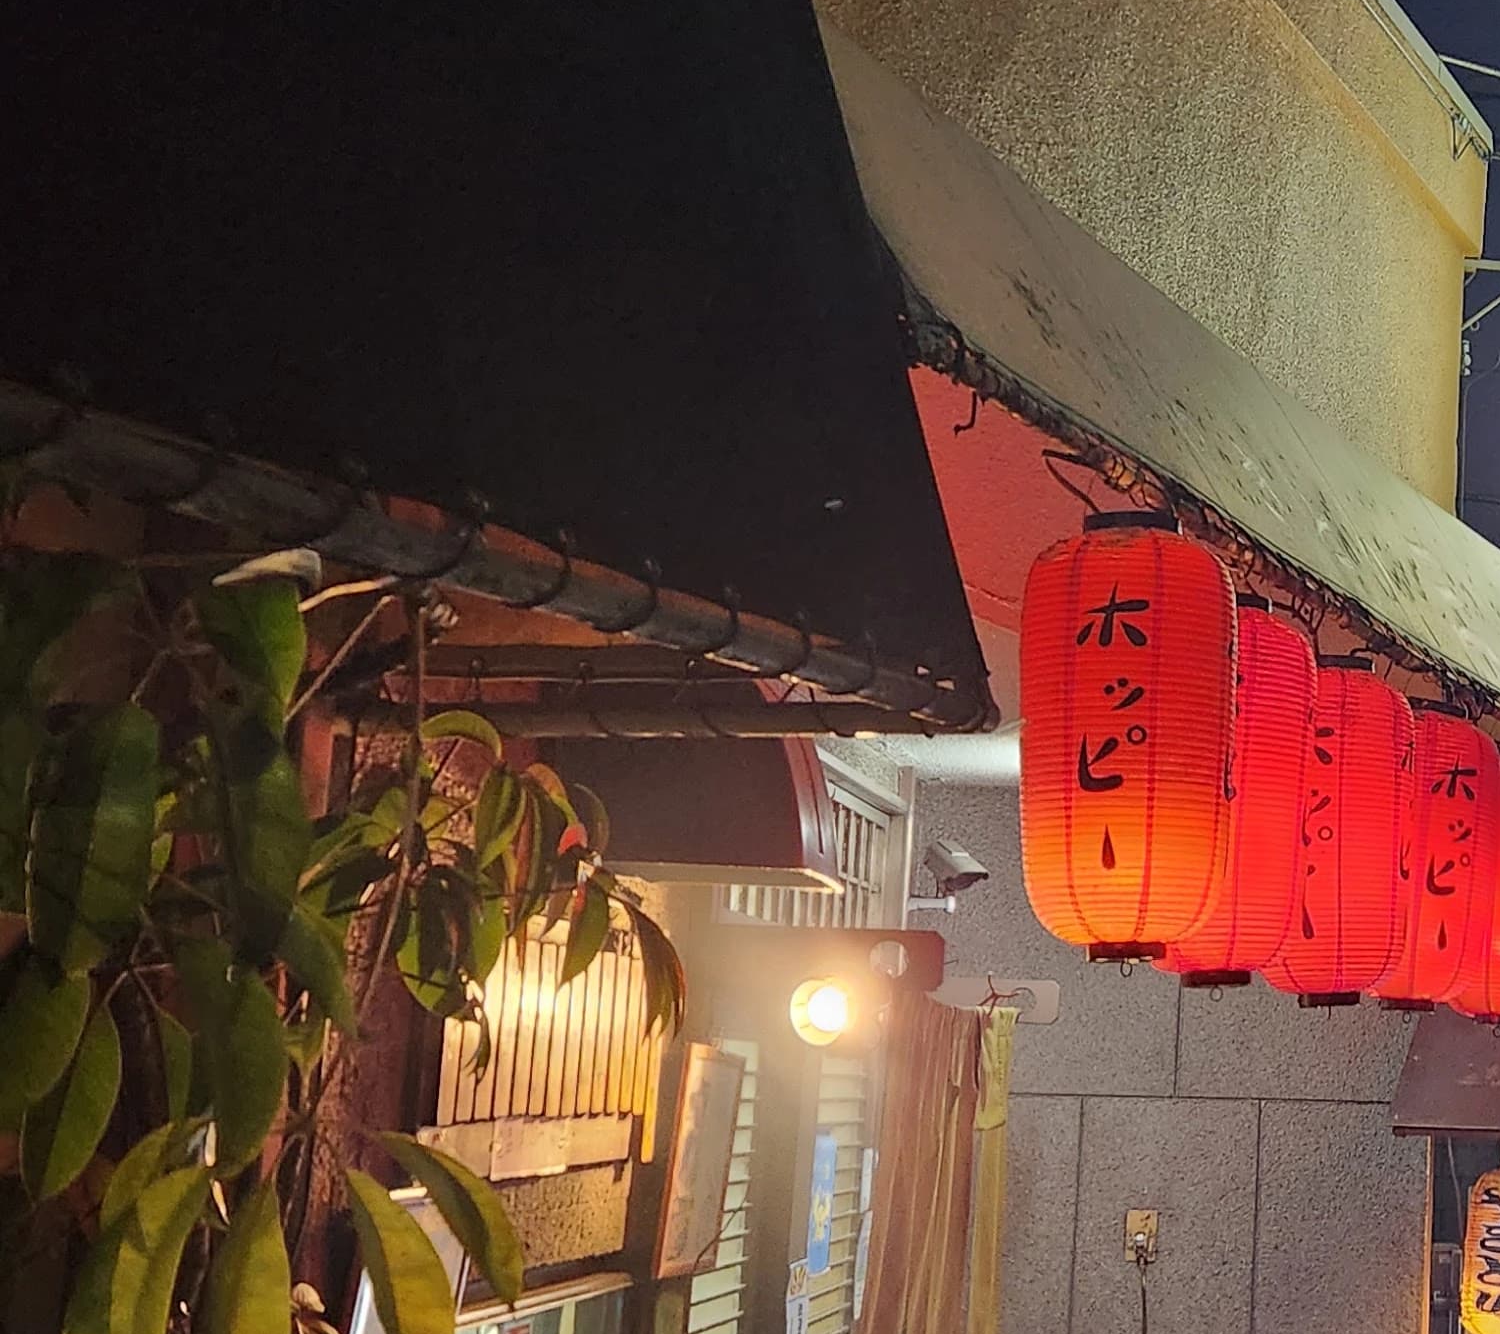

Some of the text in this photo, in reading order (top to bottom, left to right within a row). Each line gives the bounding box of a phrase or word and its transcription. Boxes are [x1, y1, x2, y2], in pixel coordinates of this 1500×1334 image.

[1076, 581, 1150, 870] ホッピー
[1426, 753, 1477, 951] ホッピー
